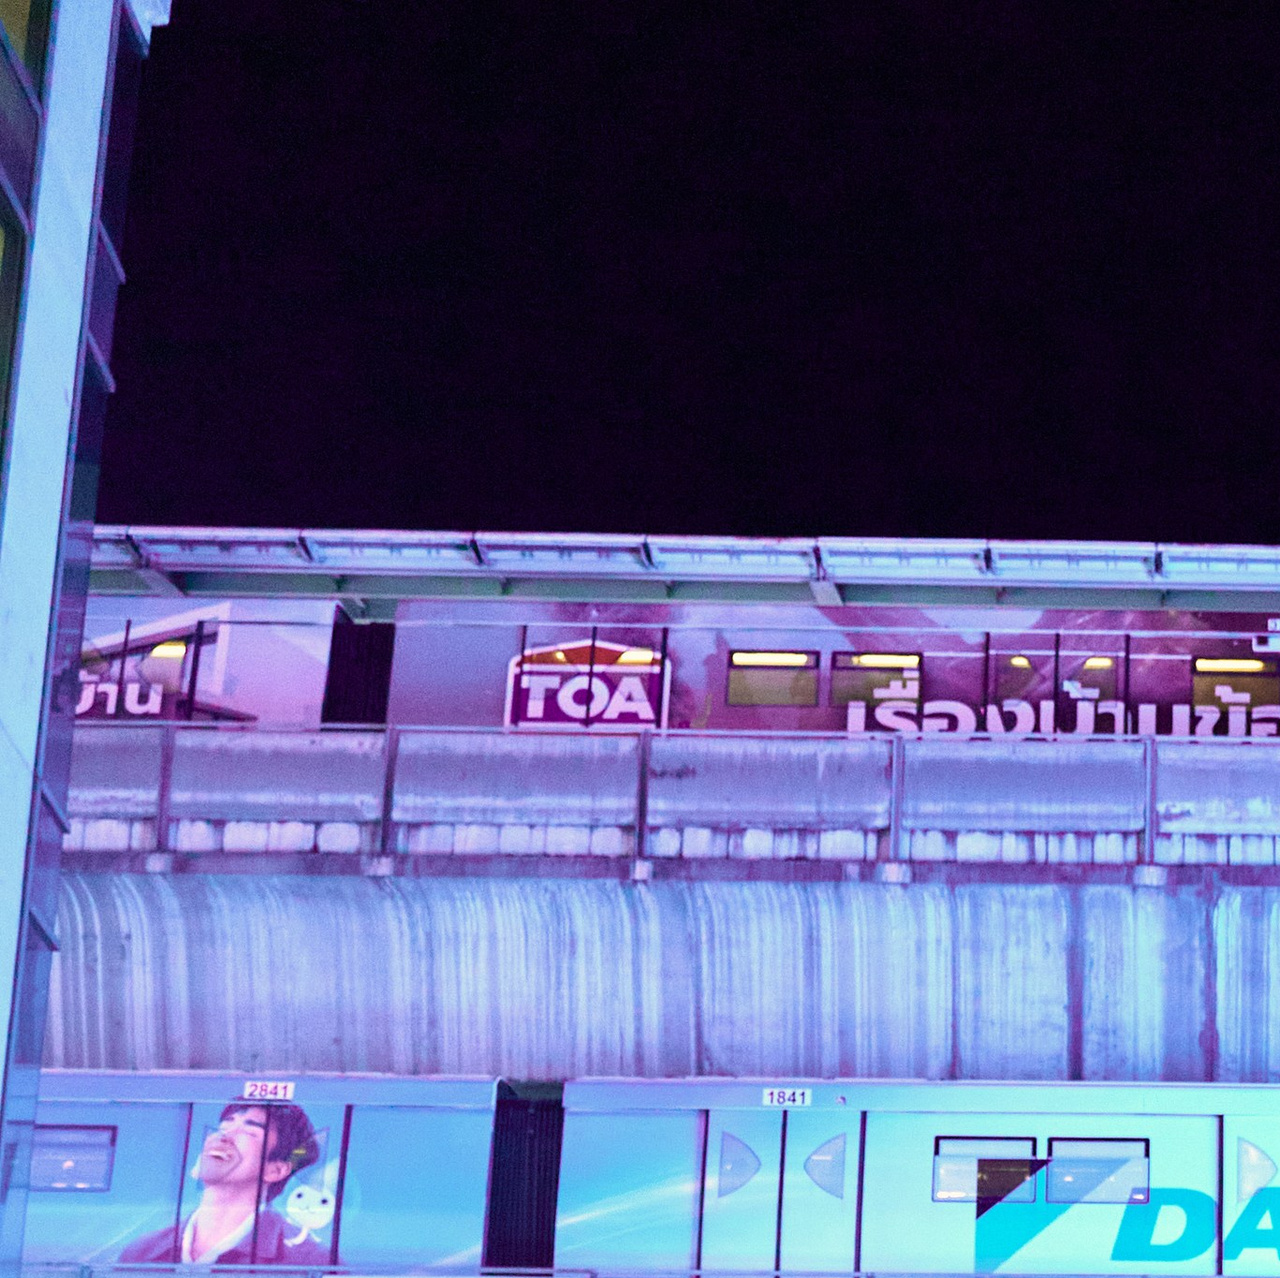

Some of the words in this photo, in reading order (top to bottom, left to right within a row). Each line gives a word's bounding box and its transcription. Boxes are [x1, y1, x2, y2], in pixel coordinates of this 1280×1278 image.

[520, 674, 656, 720] TOA
[247, 1082, 289, 1098] 2841
[768, 1090, 806, 1105] 1841
